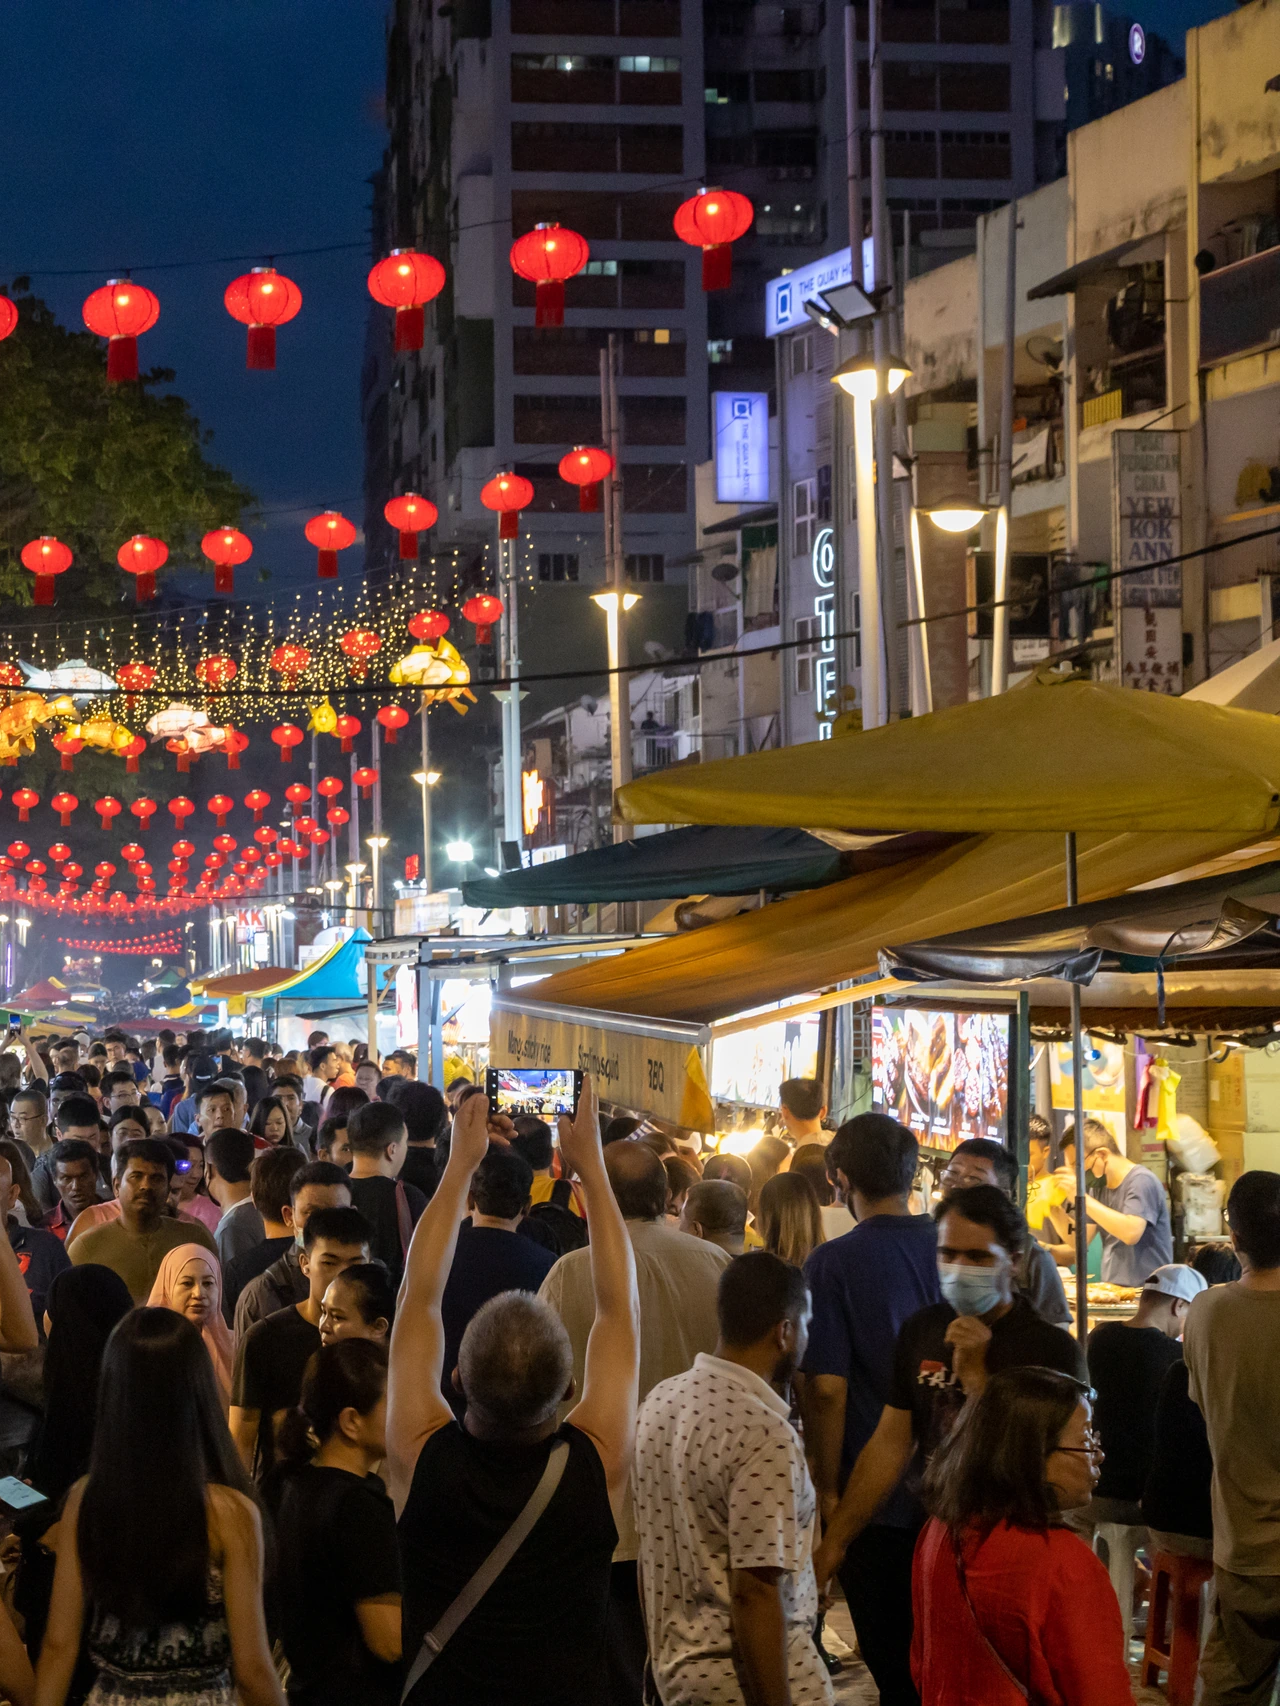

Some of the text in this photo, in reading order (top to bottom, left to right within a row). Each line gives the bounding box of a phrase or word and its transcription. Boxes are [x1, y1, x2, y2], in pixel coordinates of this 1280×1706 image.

[800, 267, 840, 295] THE QUAY
[1127, 496, 1176, 518] YEW
[1129, 519, 1172, 539] KOK
[1129, 541, 1174, 561] ANN
[238, 908, 263, 926] KK
